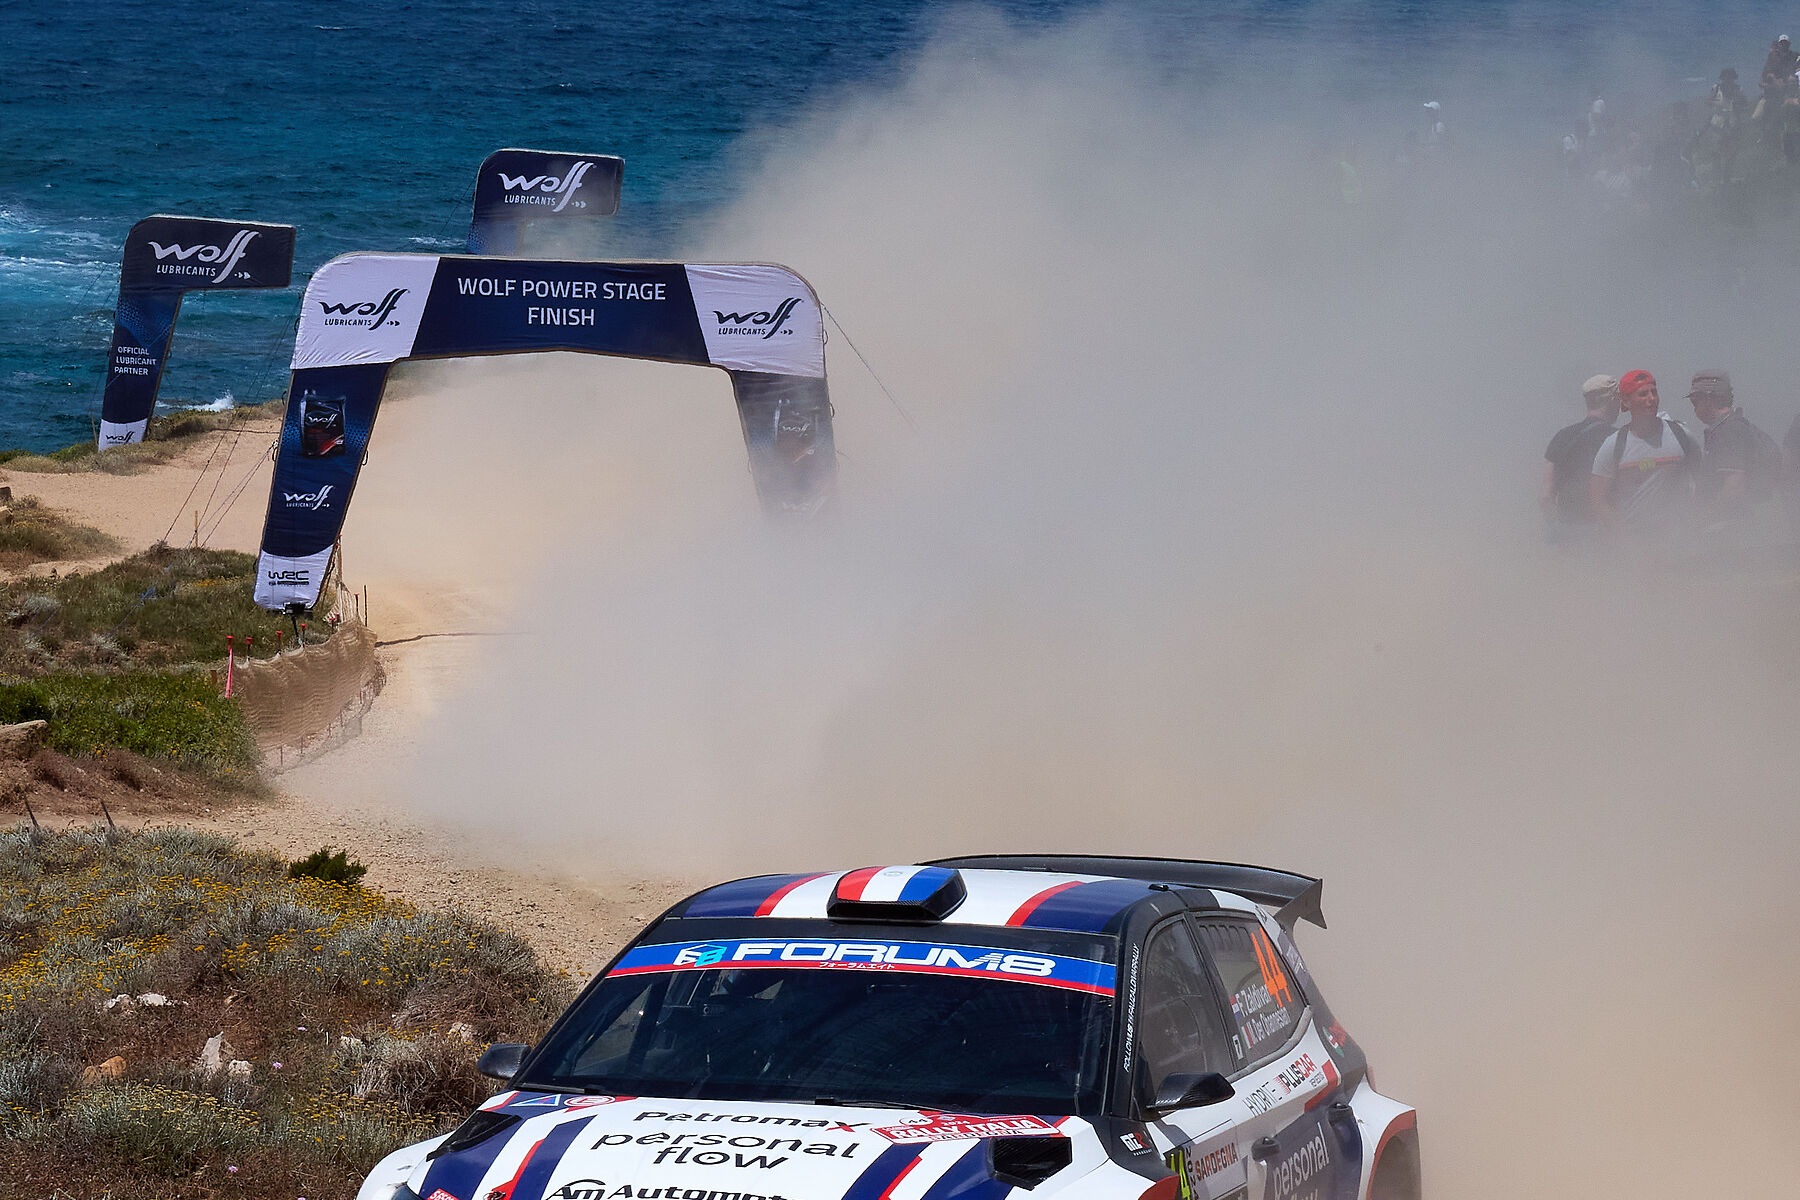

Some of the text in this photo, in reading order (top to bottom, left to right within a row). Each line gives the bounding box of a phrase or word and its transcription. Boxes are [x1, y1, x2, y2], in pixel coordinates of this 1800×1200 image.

[504, 194, 556, 206] LUBRICANTS
[156, 264, 217, 277] LUBRICANTS
[457, 277, 666, 301] WOLF POWER STAGE
[324, 318, 372, 327] LUBRICANTS
[527, 306, 595, 326] FINISH
[718, 326, 767, 336] LUBRICANTS
[117, 345, 150, 356] OFFICIAL
[114, 366, 149, 376] PARTNER
[115, 356, 157, 366] LUBRICANT
[268, 570, 309, 580] WRC
[732, 943, 1056, 976] FORUM8
[1251, 927, 1291, 1008] 44
[633, 1111, 872, 1132] Petromax
[889, 1123, 963, 1139] RALLY
[963, 1119, 1043, 1133] ITALIA
[590, 1132, 861, 1158] personal
[653, 1146, 789, 1169] flow
[1194, 1142, 1239, 1182] SARDEGNA
